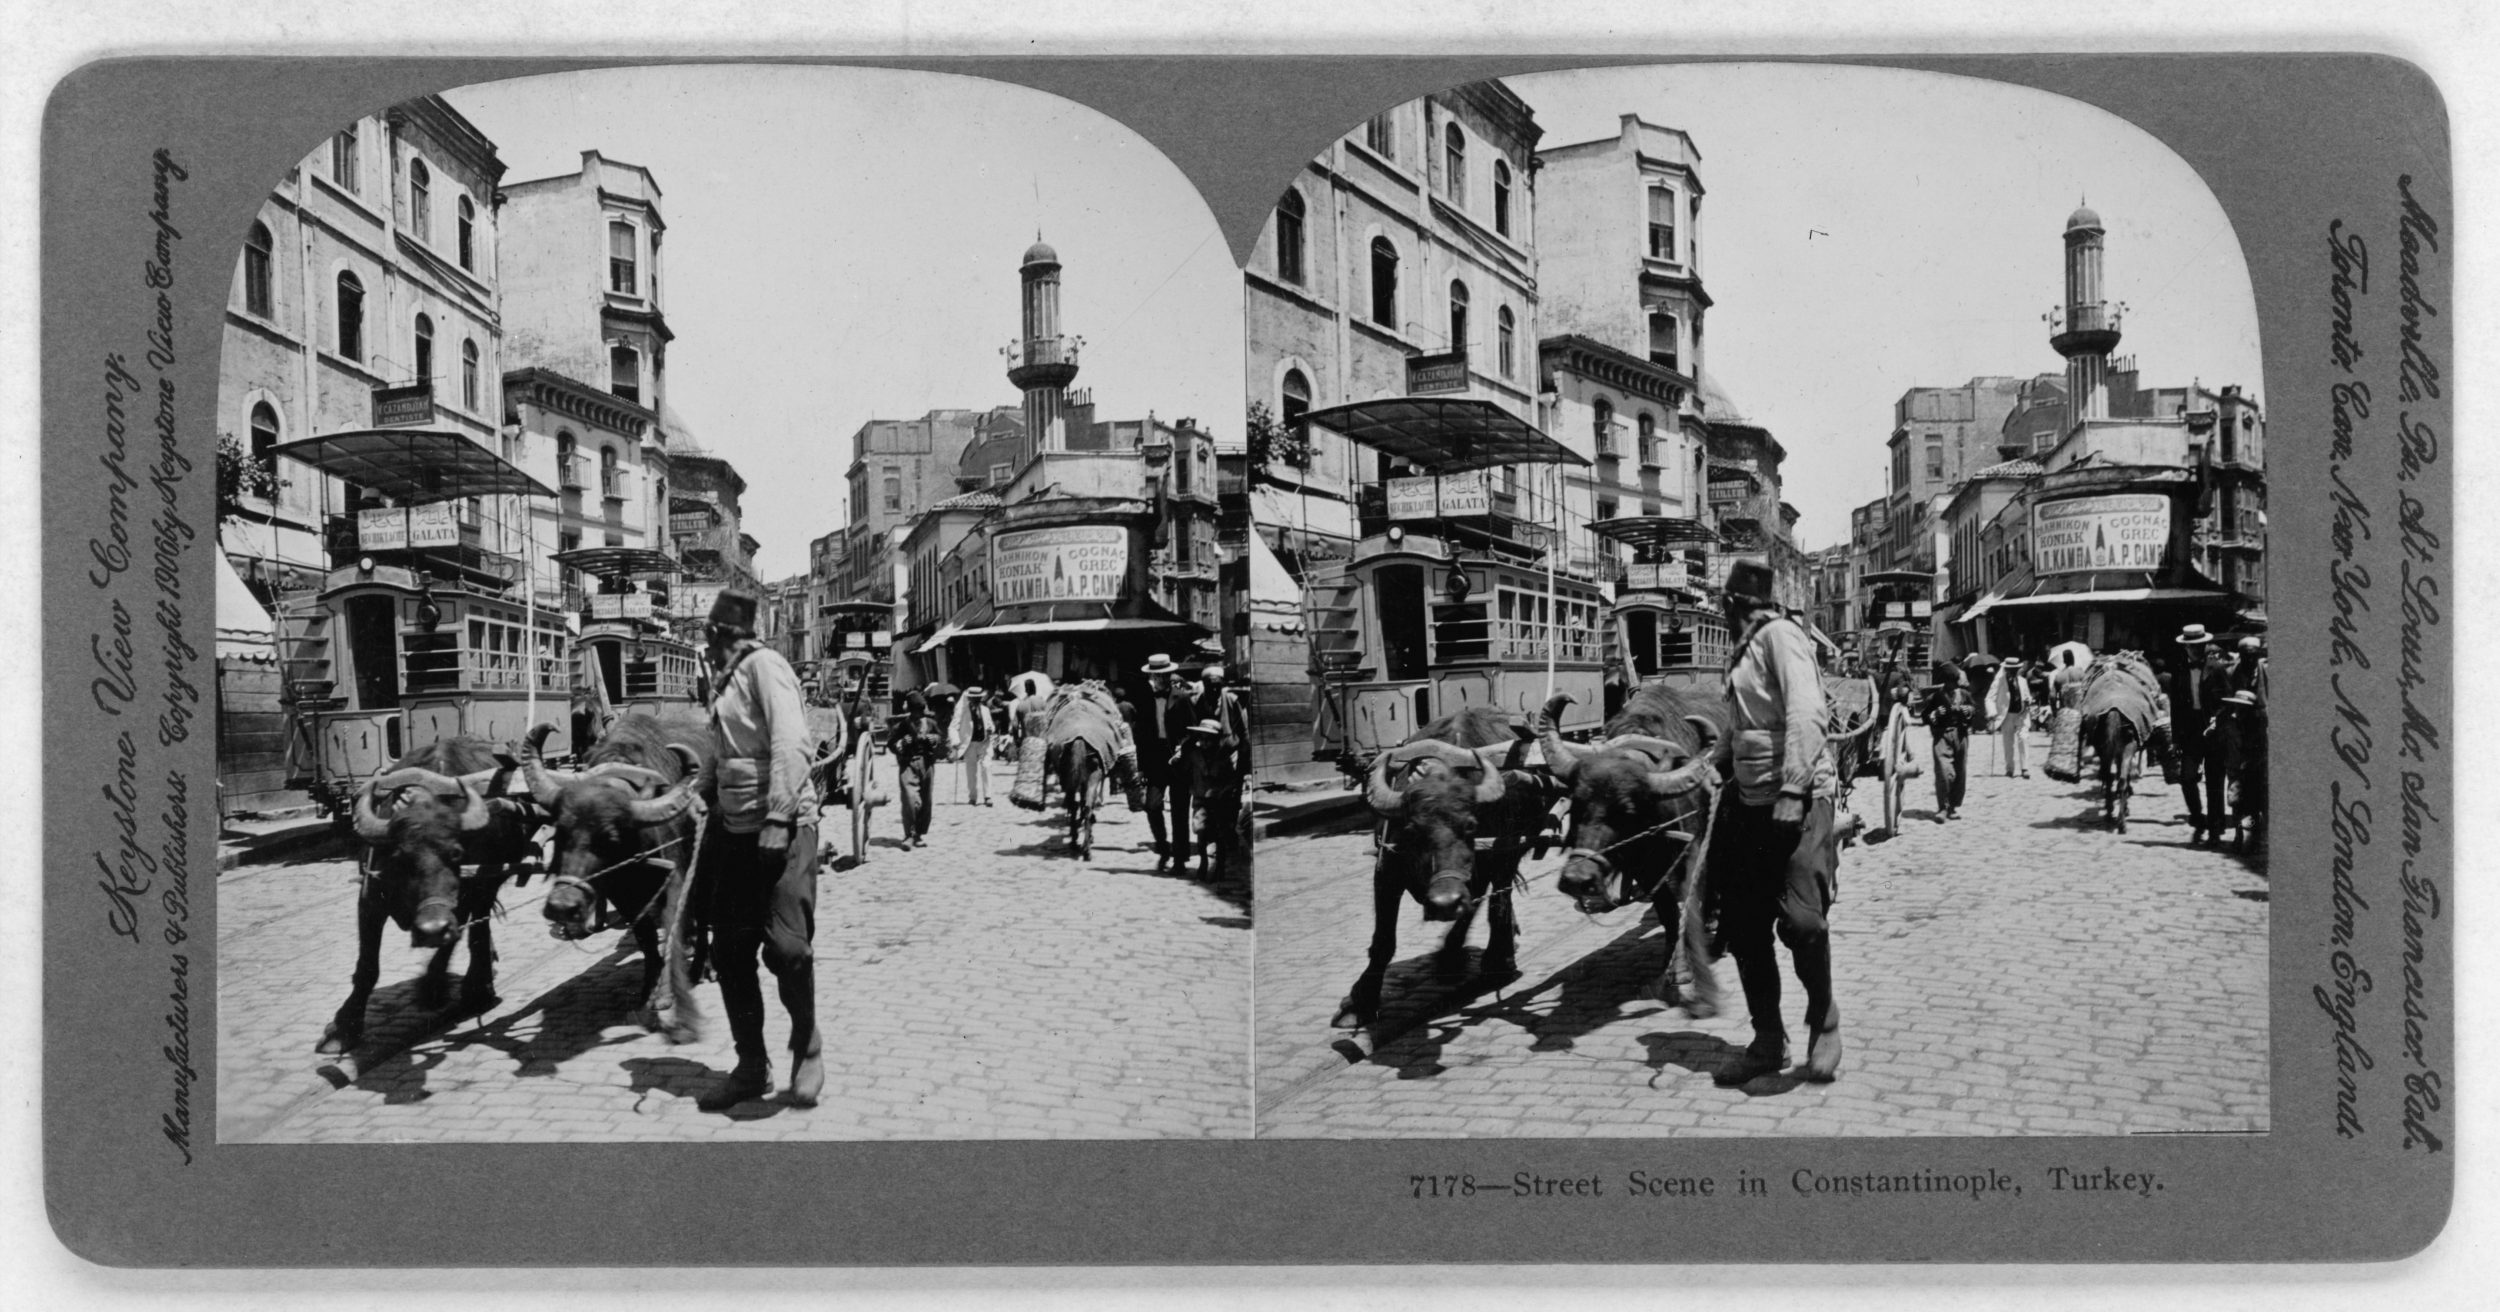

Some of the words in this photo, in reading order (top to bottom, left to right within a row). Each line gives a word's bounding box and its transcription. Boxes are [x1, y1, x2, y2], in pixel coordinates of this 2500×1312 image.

[147, 291, 175, 371] View
[150, 378, 192, 512] Keystone
[1441, 497, 1487, 511] GALATA
[2329, 464, 2371, 561] New
[412, 528, 457, 541] GALATA
[2110, 514, 2168, 530] COGNAC
[2121, 528, 2160, 541] GREC
[1068, 546, 1126, 561] COGNAC
[1079, 559, 1117, 571] GREC
[92, 599, 137, 715] View
[156, 600, 198, 747] Copyright
[1388, 702, 1396, 721] 1
[361, 731, 368, 749] 1
[2400, 770, 2440, 858] San
[93, 731, 157, 944] Keystone
[164, 919, 188, 946] &
[162, 954, 197, 1166] Manufacturers
[1628, 1170, 1715, 1197] Scene
[1737, 1169, 1769, 1196] in
[1791, 1167, 2023, 1200] Constantinople,
[2046, 1166, 2165, 1199] Turkey.
